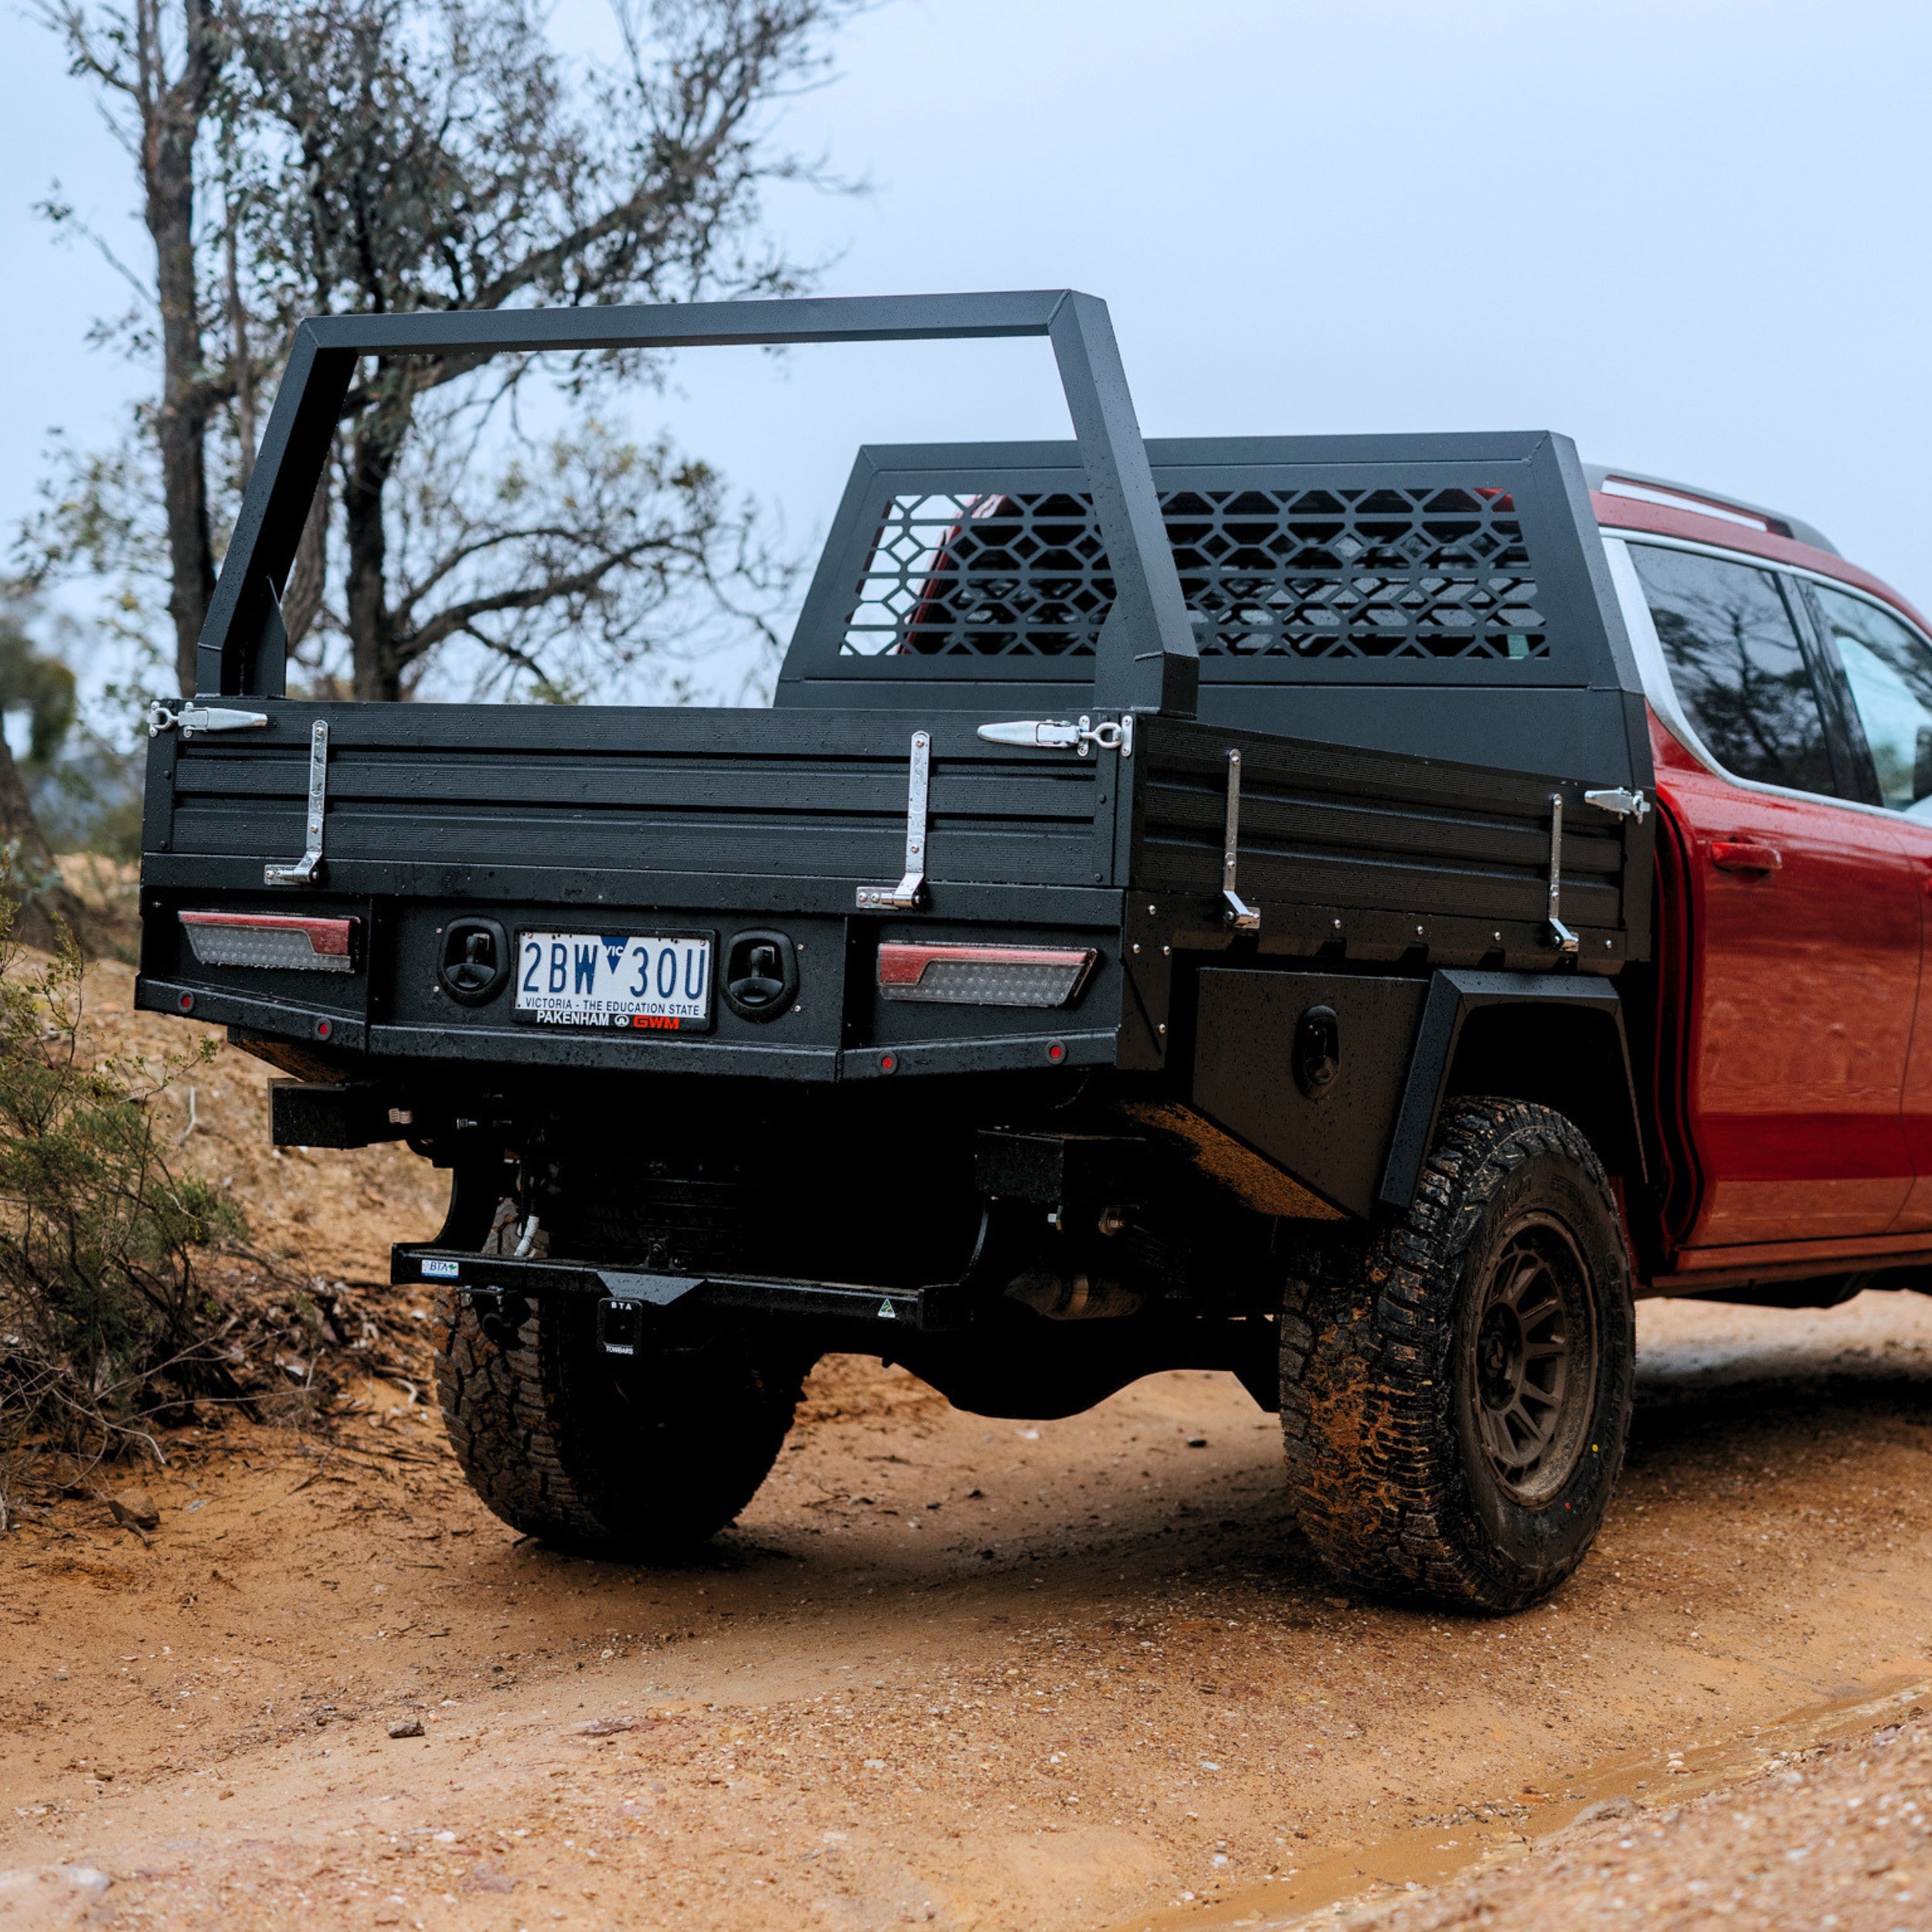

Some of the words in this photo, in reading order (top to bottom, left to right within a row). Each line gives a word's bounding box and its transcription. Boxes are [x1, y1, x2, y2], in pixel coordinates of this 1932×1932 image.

[604, 945, 624, 957] VIC
[522, 941, 598, 995] 2BW
[526, 997, 572, 1009] VICTORIA
[583, 999, 603, 1011] THE
[606, 1001, 665, 1014] EDUCATION
[668, 1004, 699, 1016] STATE
[536, 1009, 610, 1026] PAKENHAM
[632, 1014, 680, 1030] GWM
[430, 1260, 448, 1271] BTA
[605, 1345, 634, 1355] TOWBARS
